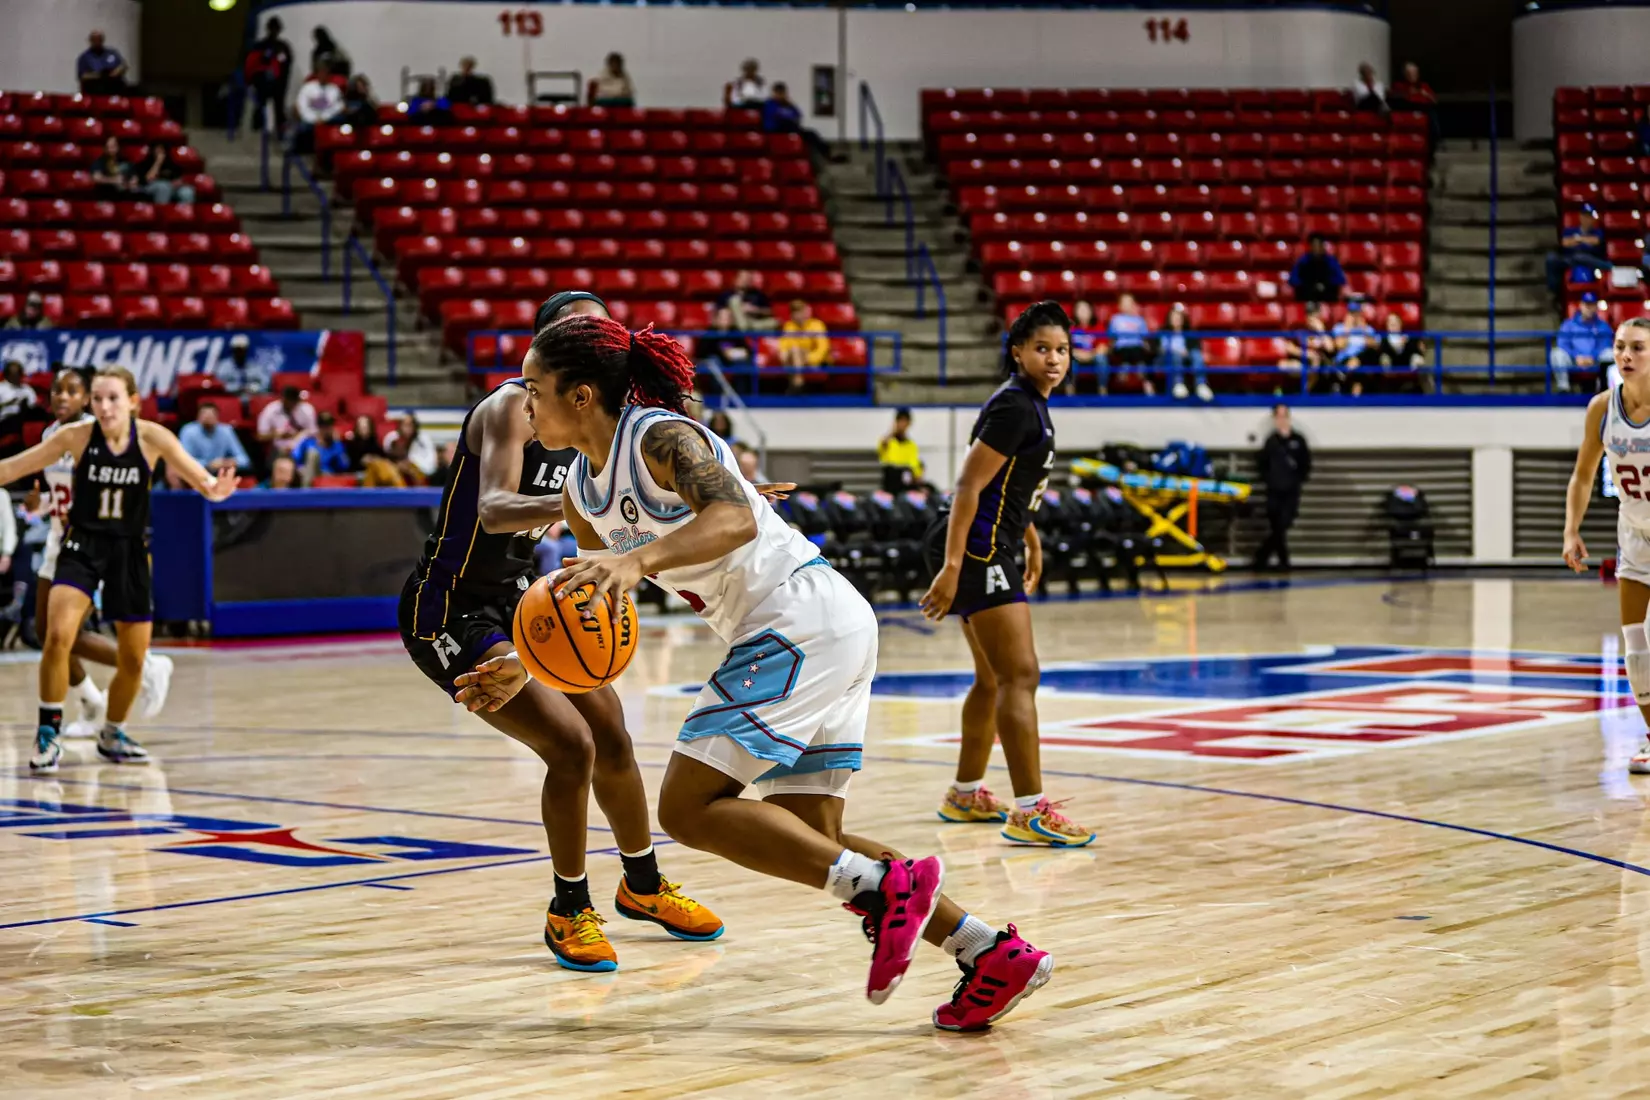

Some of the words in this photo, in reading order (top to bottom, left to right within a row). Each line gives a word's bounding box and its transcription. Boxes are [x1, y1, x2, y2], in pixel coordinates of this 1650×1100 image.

[498, 10, 543, 37] 113
[1144, 17, 1190, 44] 114
[88, 464, 140, 484] LSUA
[532, 462, 567, 489] LS
[98, 488, 123, 519] 11
